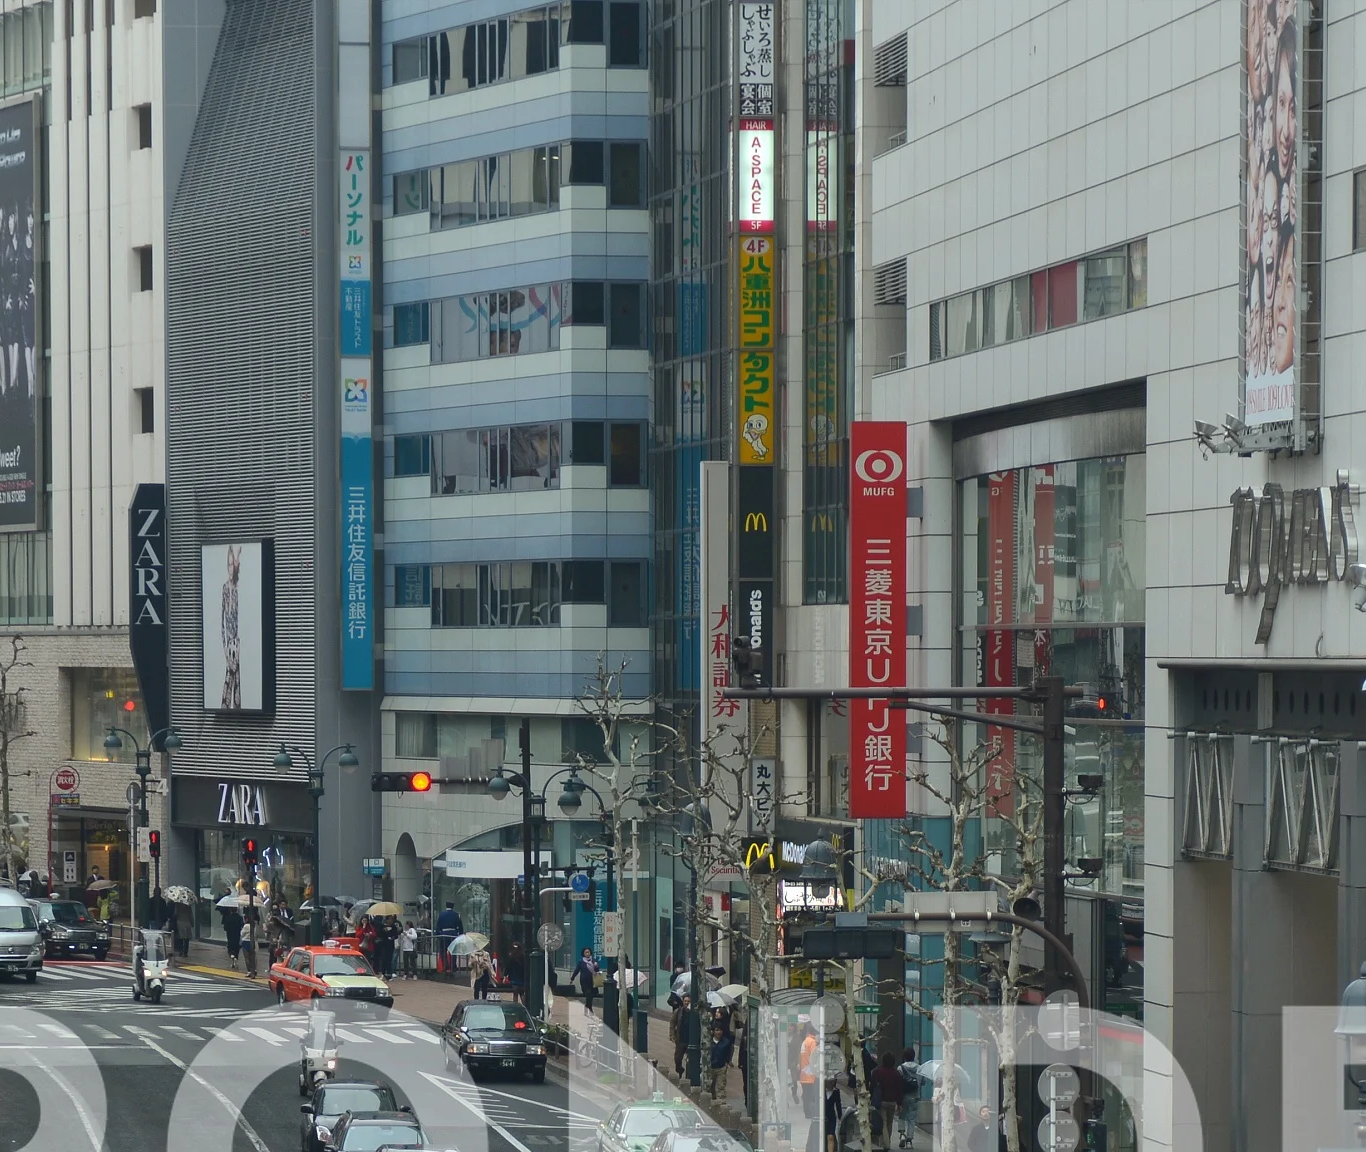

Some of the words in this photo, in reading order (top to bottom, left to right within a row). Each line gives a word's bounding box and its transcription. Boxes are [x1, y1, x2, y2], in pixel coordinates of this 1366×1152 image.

[740, 4, 757, 78] しゃぶしゃぶ
[757, 4, 773, 78] せいろ蒸し
[741, 84, 756, 115] 宴会
[745, 121, 767, 130] HAIR
[757, 84, 773, 115] 個室
[346, 155, 363, 246] パーソナル
[751, 136, 761, 214] A-SPACE
[746, 239, 765, 253] 4F
[751, 221, 762, 230] 5F
[353, 287, 362, 348] 三井住友トラスト
[742, 256, 771, 412] 八重洲コンタクト
[863, 488, 895, 496] MUFG
[135, 509, 164, 625] ZARA
[348, 486, 366, 640] 三井住友信託銀行
[218, 782, 267, 826] ZARA
[755, 763, 772, 827] 丸大ビル
